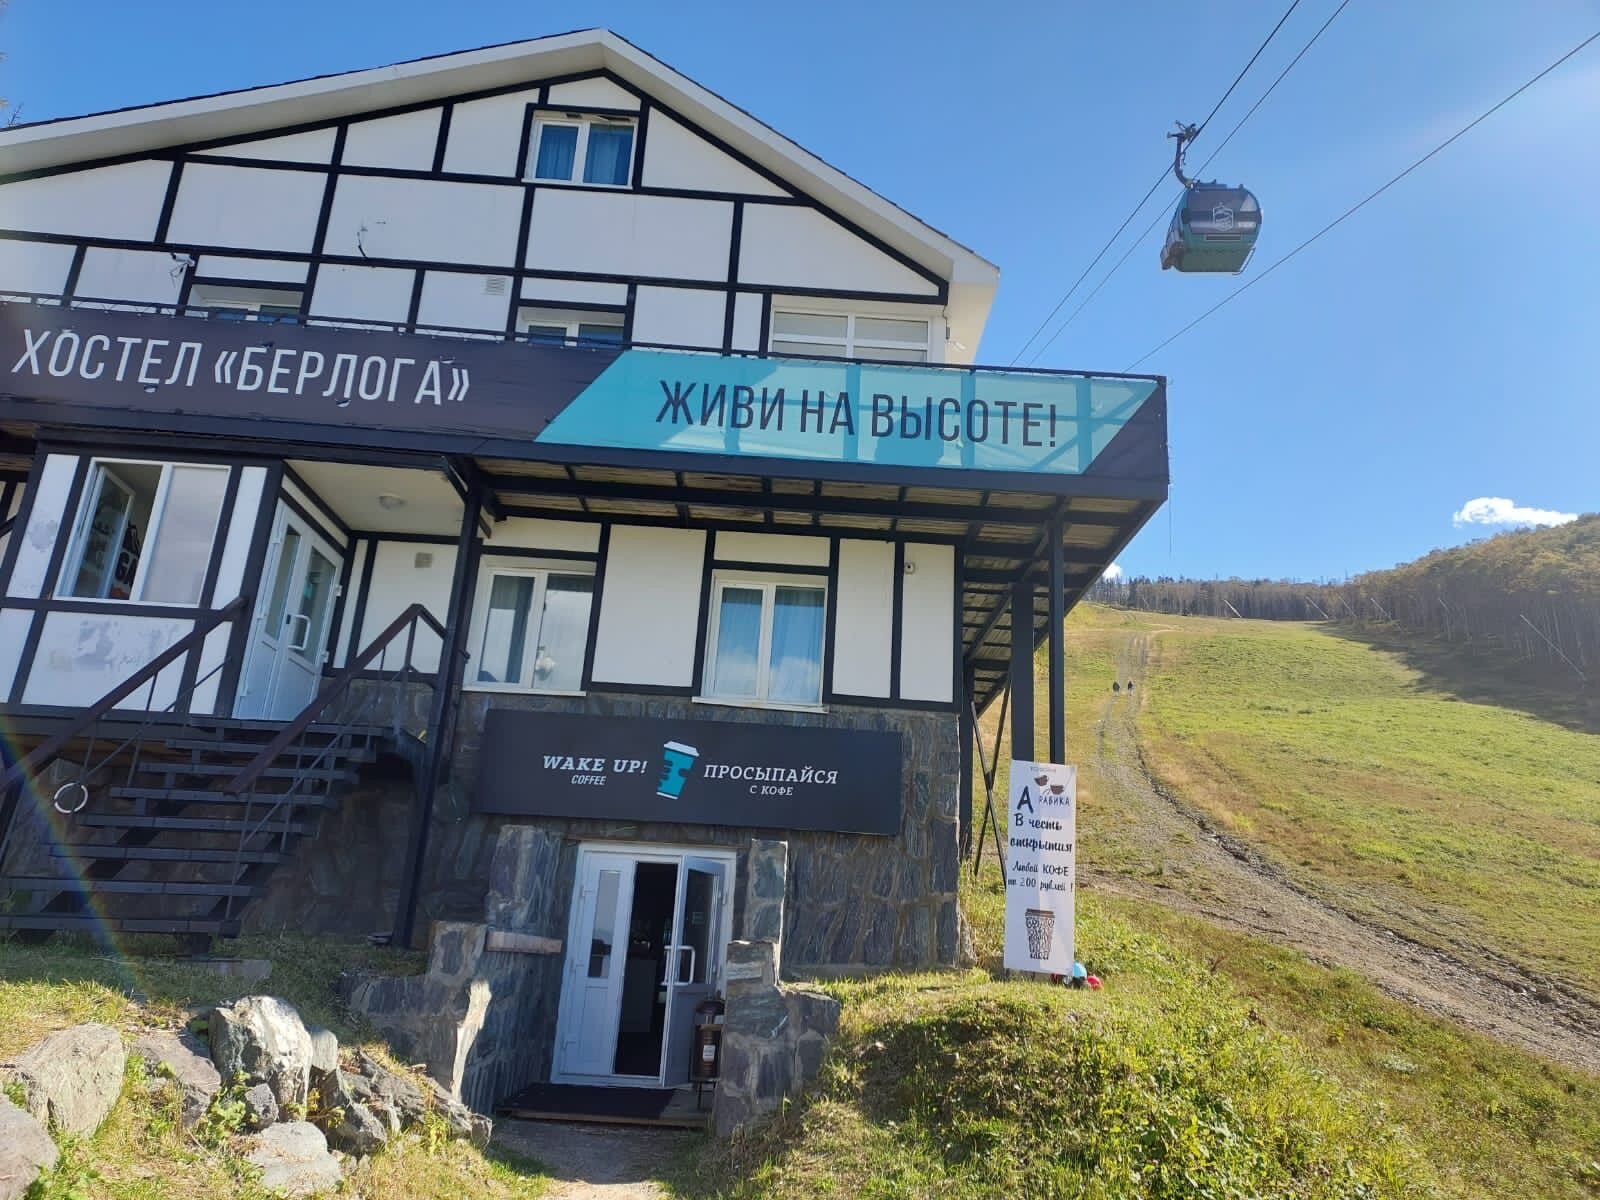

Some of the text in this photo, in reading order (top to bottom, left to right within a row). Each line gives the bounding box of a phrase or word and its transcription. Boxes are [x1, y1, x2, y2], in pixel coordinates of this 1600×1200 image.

[12, 328, 470, 405] ХОСТЕЛ «БЕРЛОГА»
[656, 380, 1057, 448] ЖИВИ НА ВЫСОТЕ!
[543, 755, 648, 774] WAKE UP!
[571, 773, 607, 786] COFFEE
[703, 764, 838, 784] ПРОСЫПАЙСЯ
[749, 785, 794, 796] С КОФЕ
[1014, 813, 1062, 831] В честь
[1010, 837, 1072, 852] открытия
[1012, 860, 1069, 877] Любой КОФЕ
